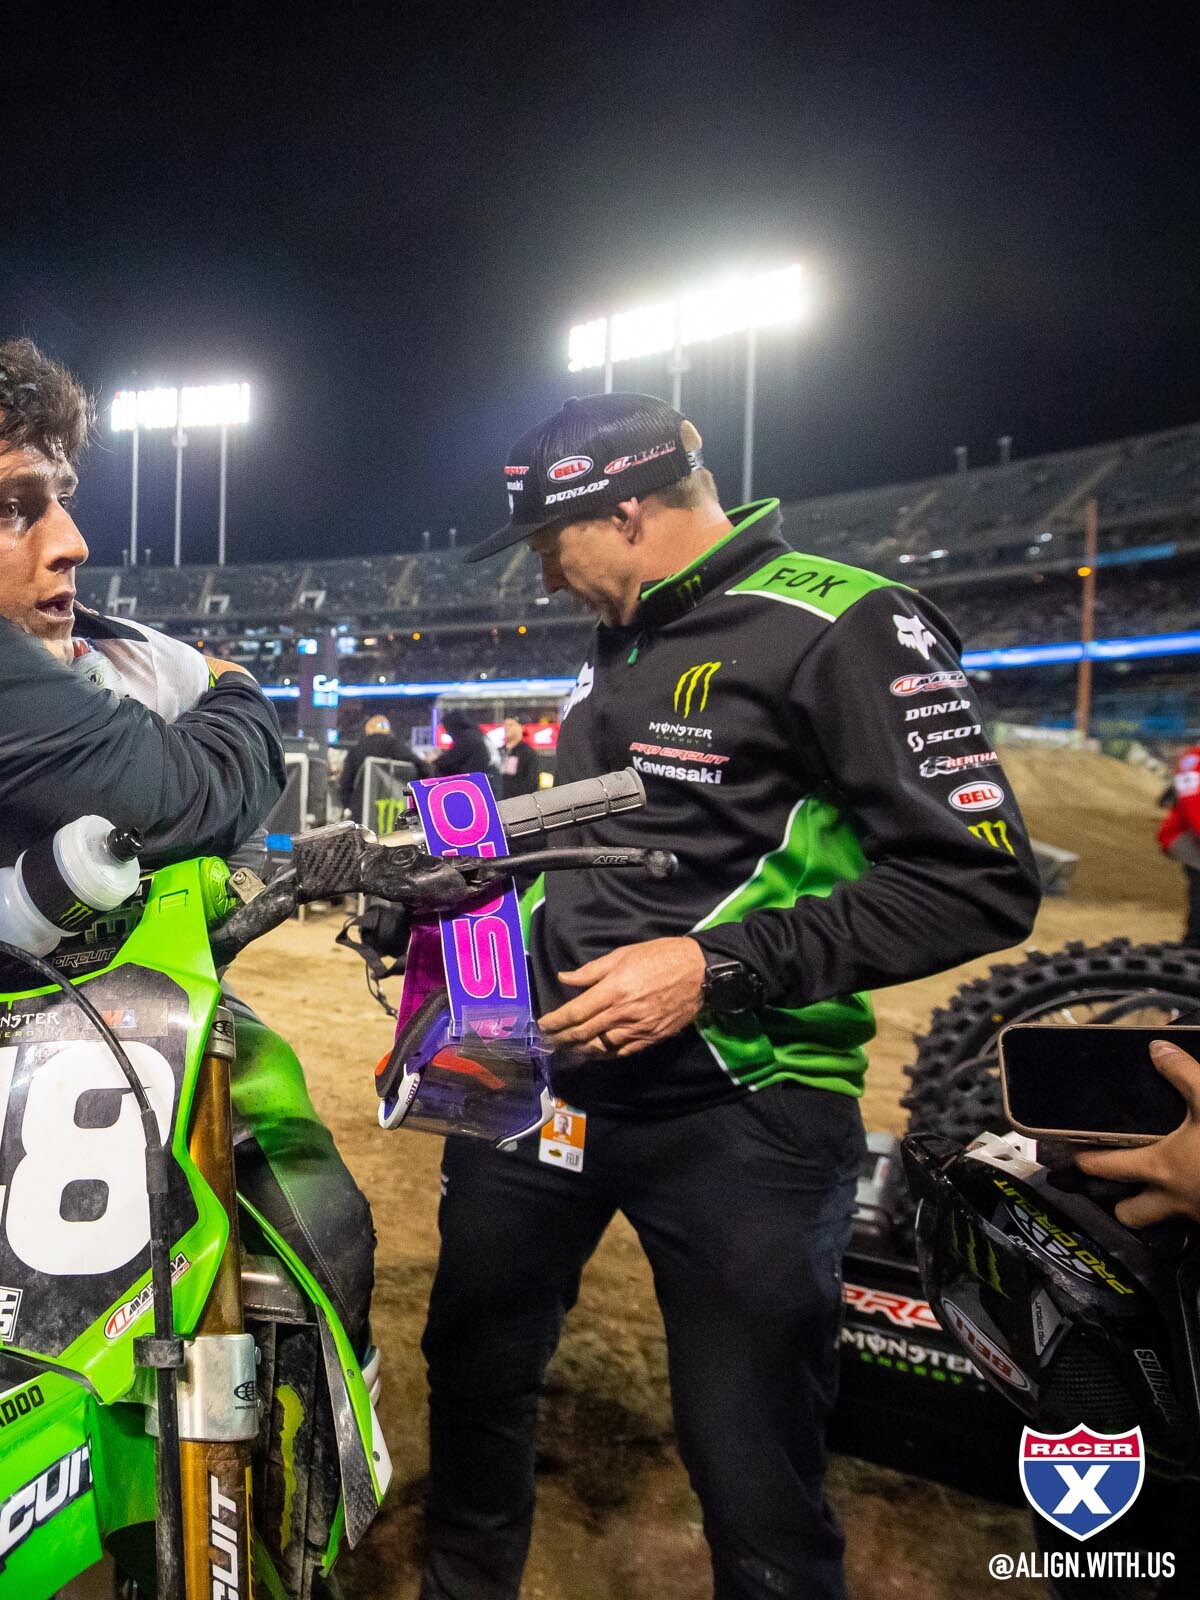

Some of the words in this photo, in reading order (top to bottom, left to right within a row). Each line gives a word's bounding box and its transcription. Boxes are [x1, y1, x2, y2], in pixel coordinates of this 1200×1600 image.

[553, 461, 586, 479] BELL
[544, 479, 610, 505] DUNLOP
[632, 756, 723, 785] Kawasaki
[958, 789, 998, 805] BELL
[593, 856, 628, 865] ARC
